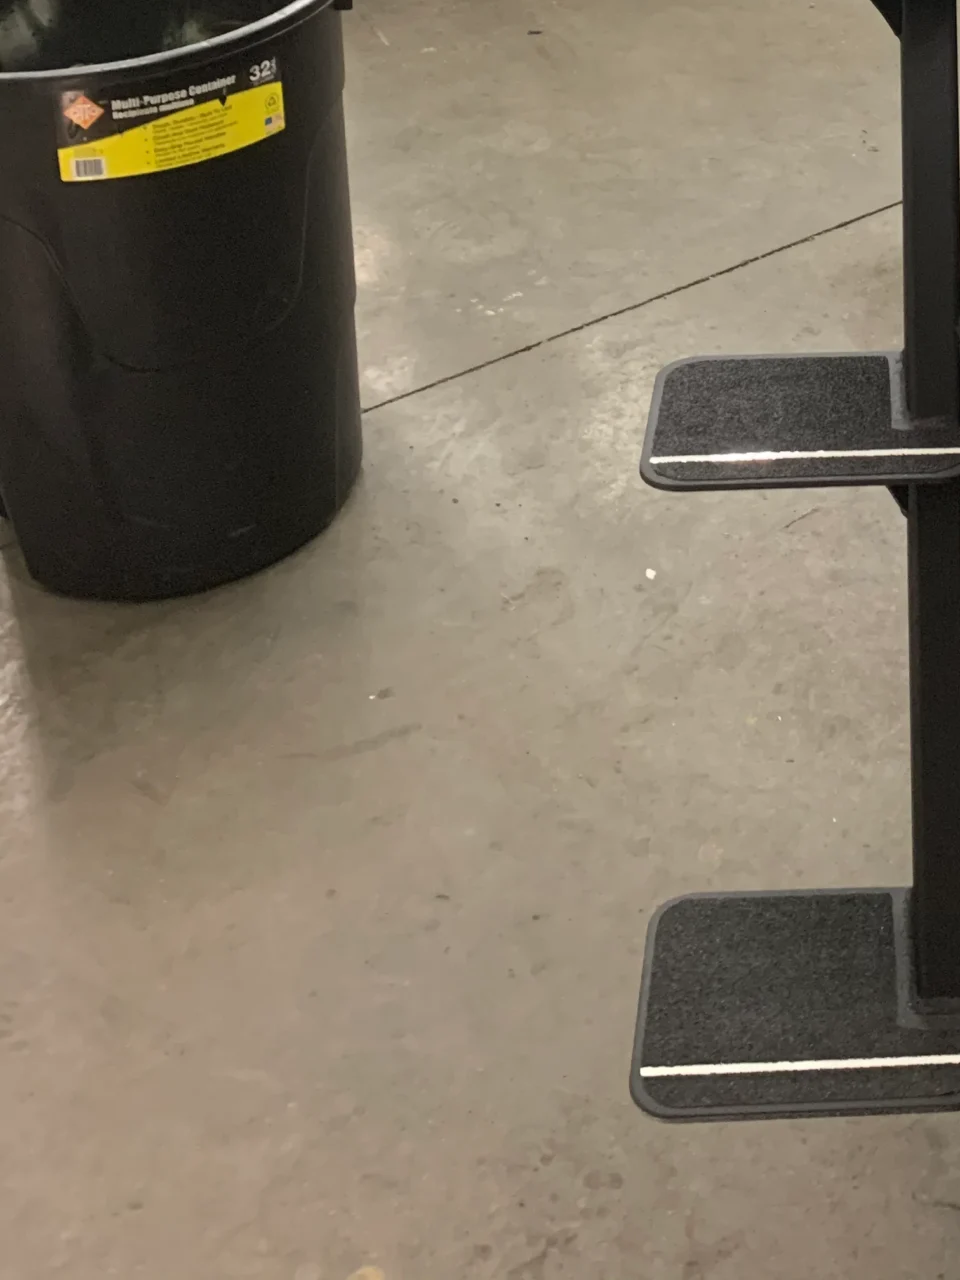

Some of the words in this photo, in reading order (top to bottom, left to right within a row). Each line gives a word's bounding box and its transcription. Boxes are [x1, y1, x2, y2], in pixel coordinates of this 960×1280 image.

[249, 60, 271, 81] 32
[111, 89, 188, 111] Multi-Purpose
[188, 74, 236, 96] Container
